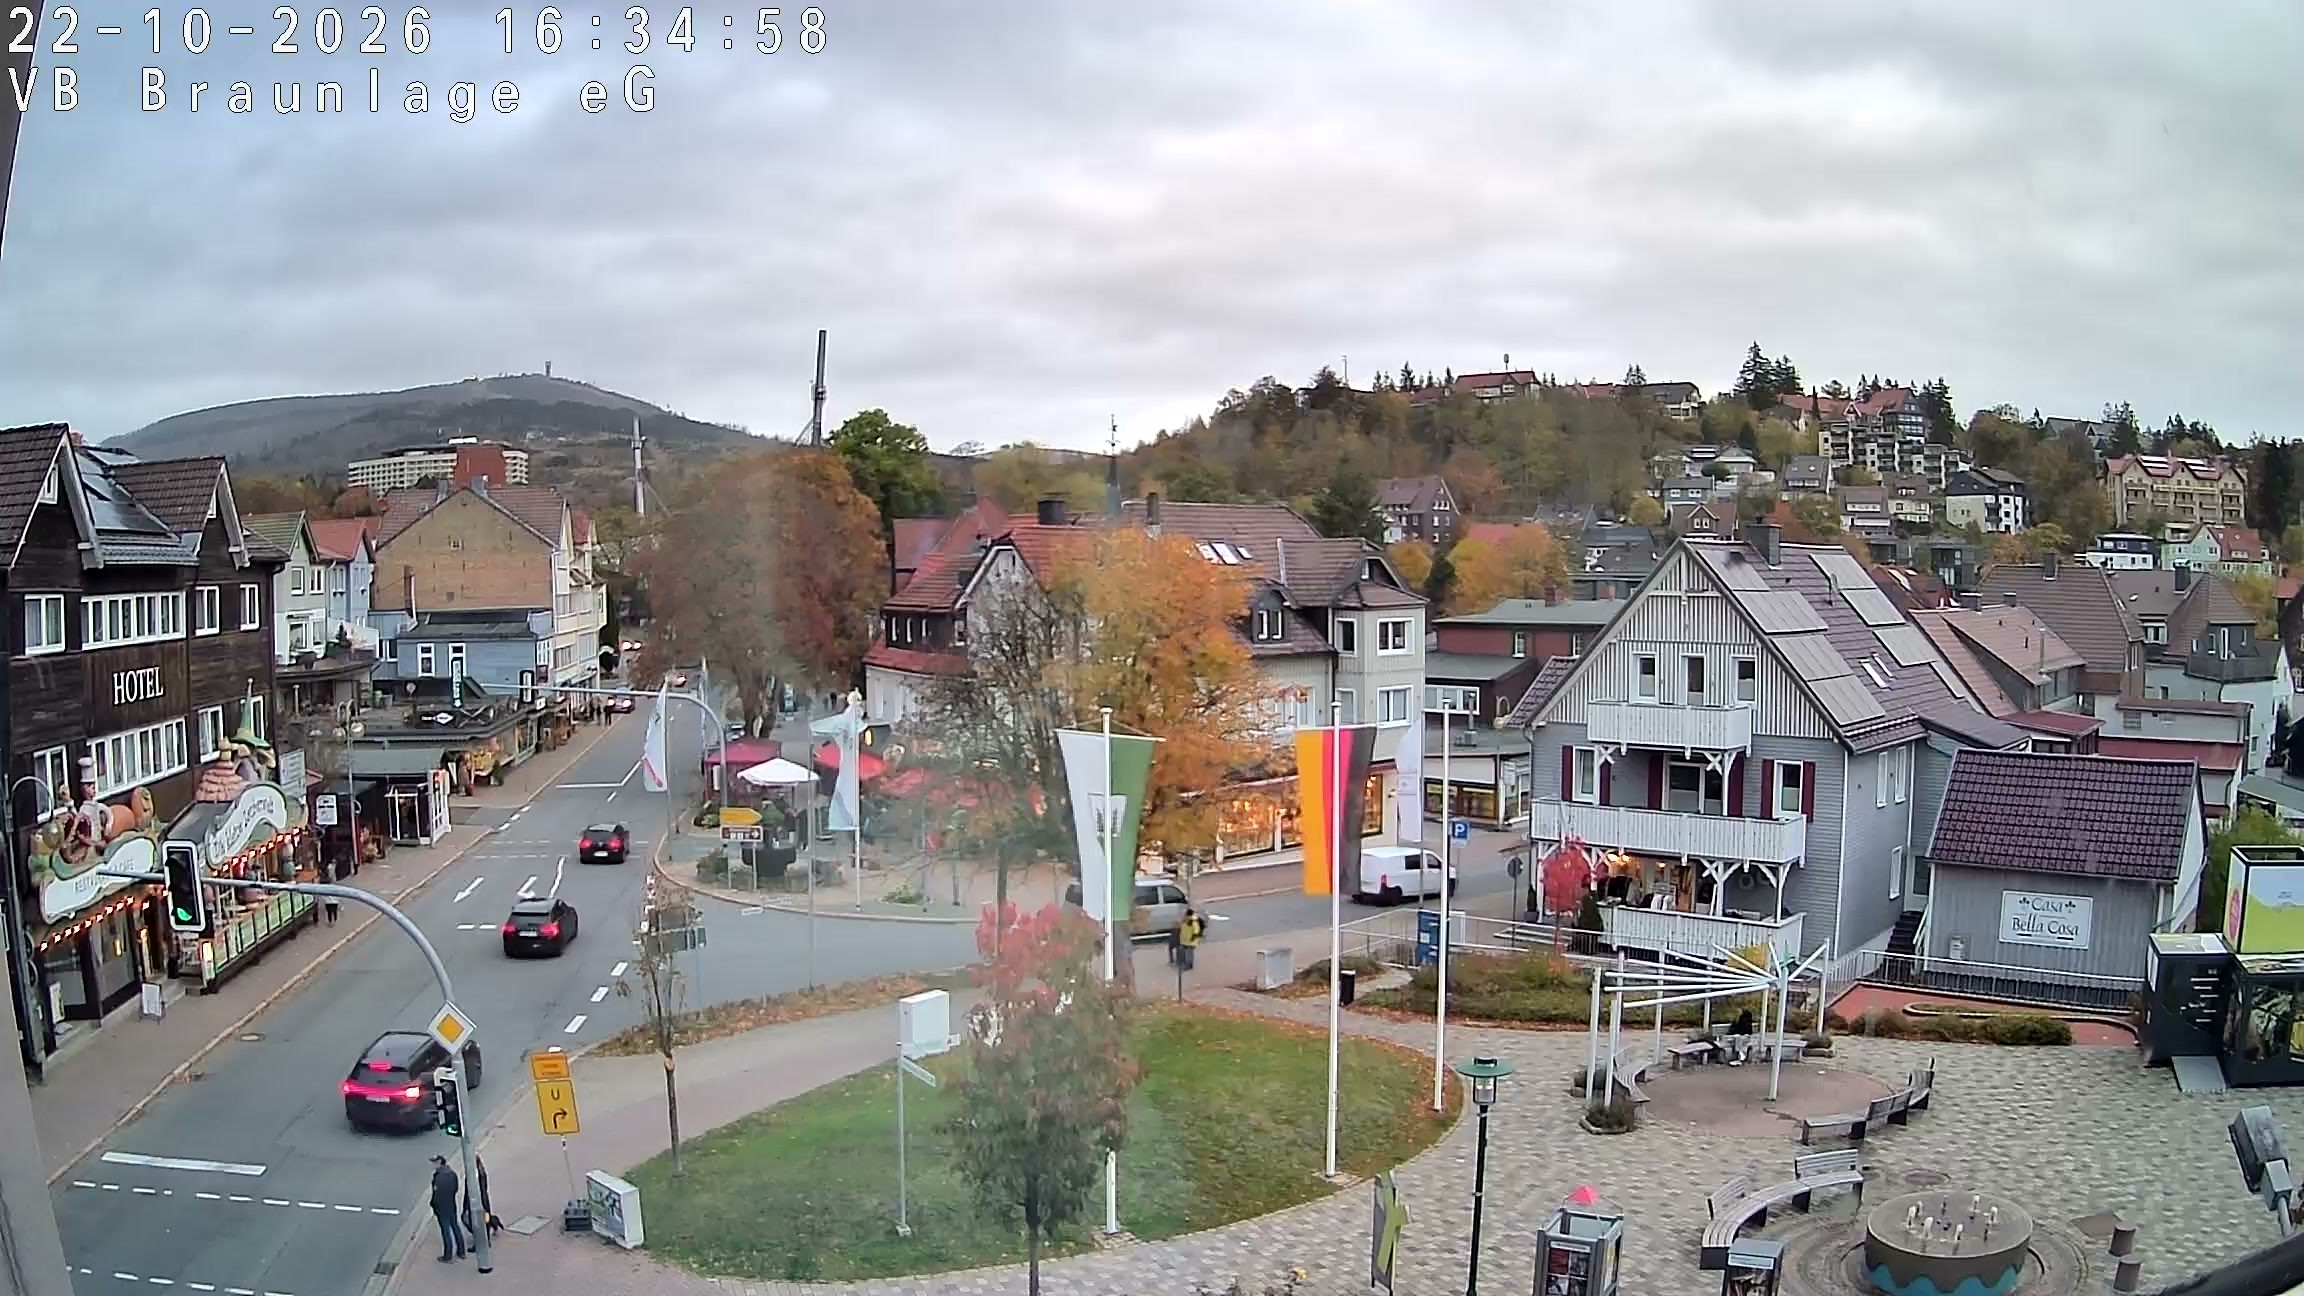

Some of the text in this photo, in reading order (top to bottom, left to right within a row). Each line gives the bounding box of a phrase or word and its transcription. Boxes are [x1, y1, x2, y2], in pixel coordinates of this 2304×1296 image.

[113, 666, 164, 705] HOTEL
[1455, 823, 1465, 837] P
[2031, 897, 2063, 912] Casa
[2012, 913, 2079, 936] Bella Casa
[551, 1088, 560, 1100] U
